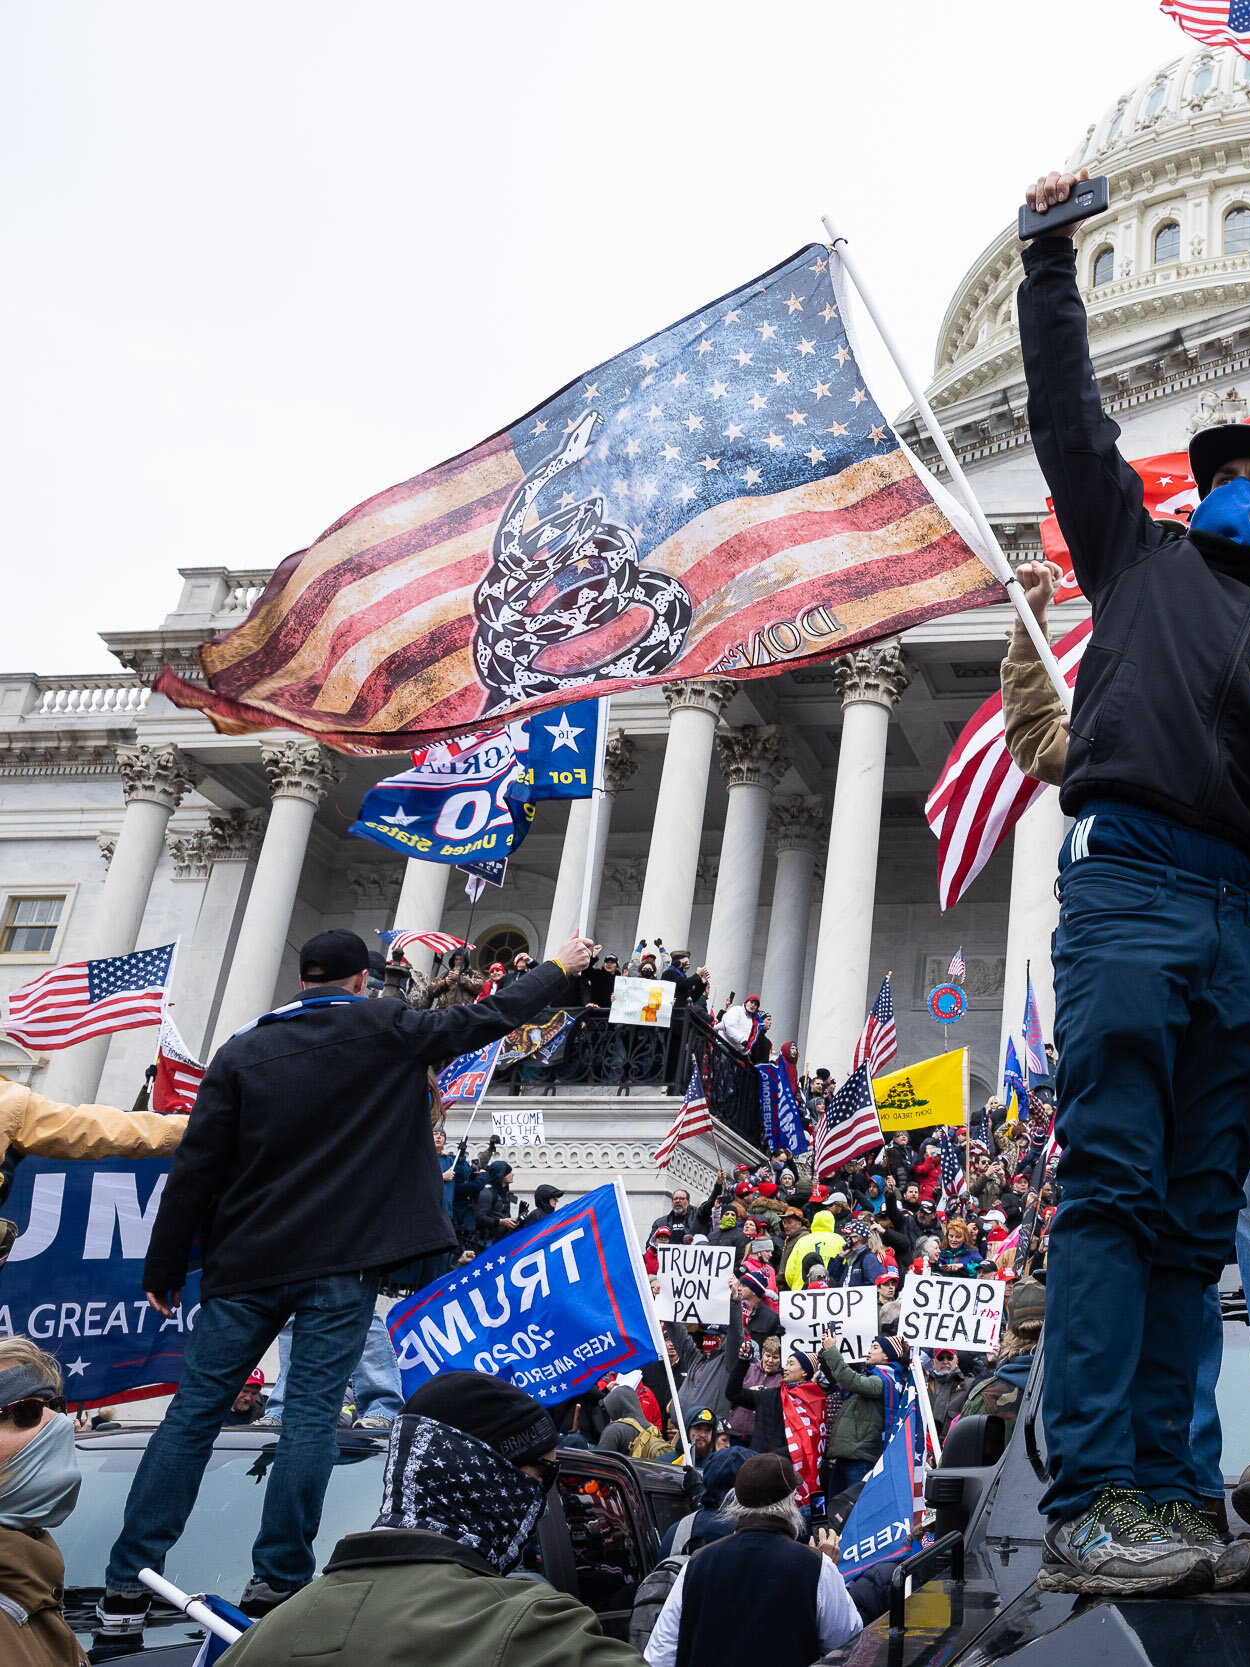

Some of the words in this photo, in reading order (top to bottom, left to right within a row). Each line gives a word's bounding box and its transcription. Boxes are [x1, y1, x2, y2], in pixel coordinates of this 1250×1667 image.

[762, 1081, 772, 1111] MORE
[492, 1111, 544, 1126] WELCOME
[496, 1125, 512, 1136] TO
[517, 1124, 538, 1136] THE
[658, 1246, 732, 1278] TRUMP
[671, 1277, 711, 1301] WON
[912, 1279, 996, 1316] STOP
[979, 1308, 1000, 1321] the
[27, 1301, 151, 1339] GREAT
[673, 1300, 703, 1325] PA
[788, 1289, 864, 1321] STOP
